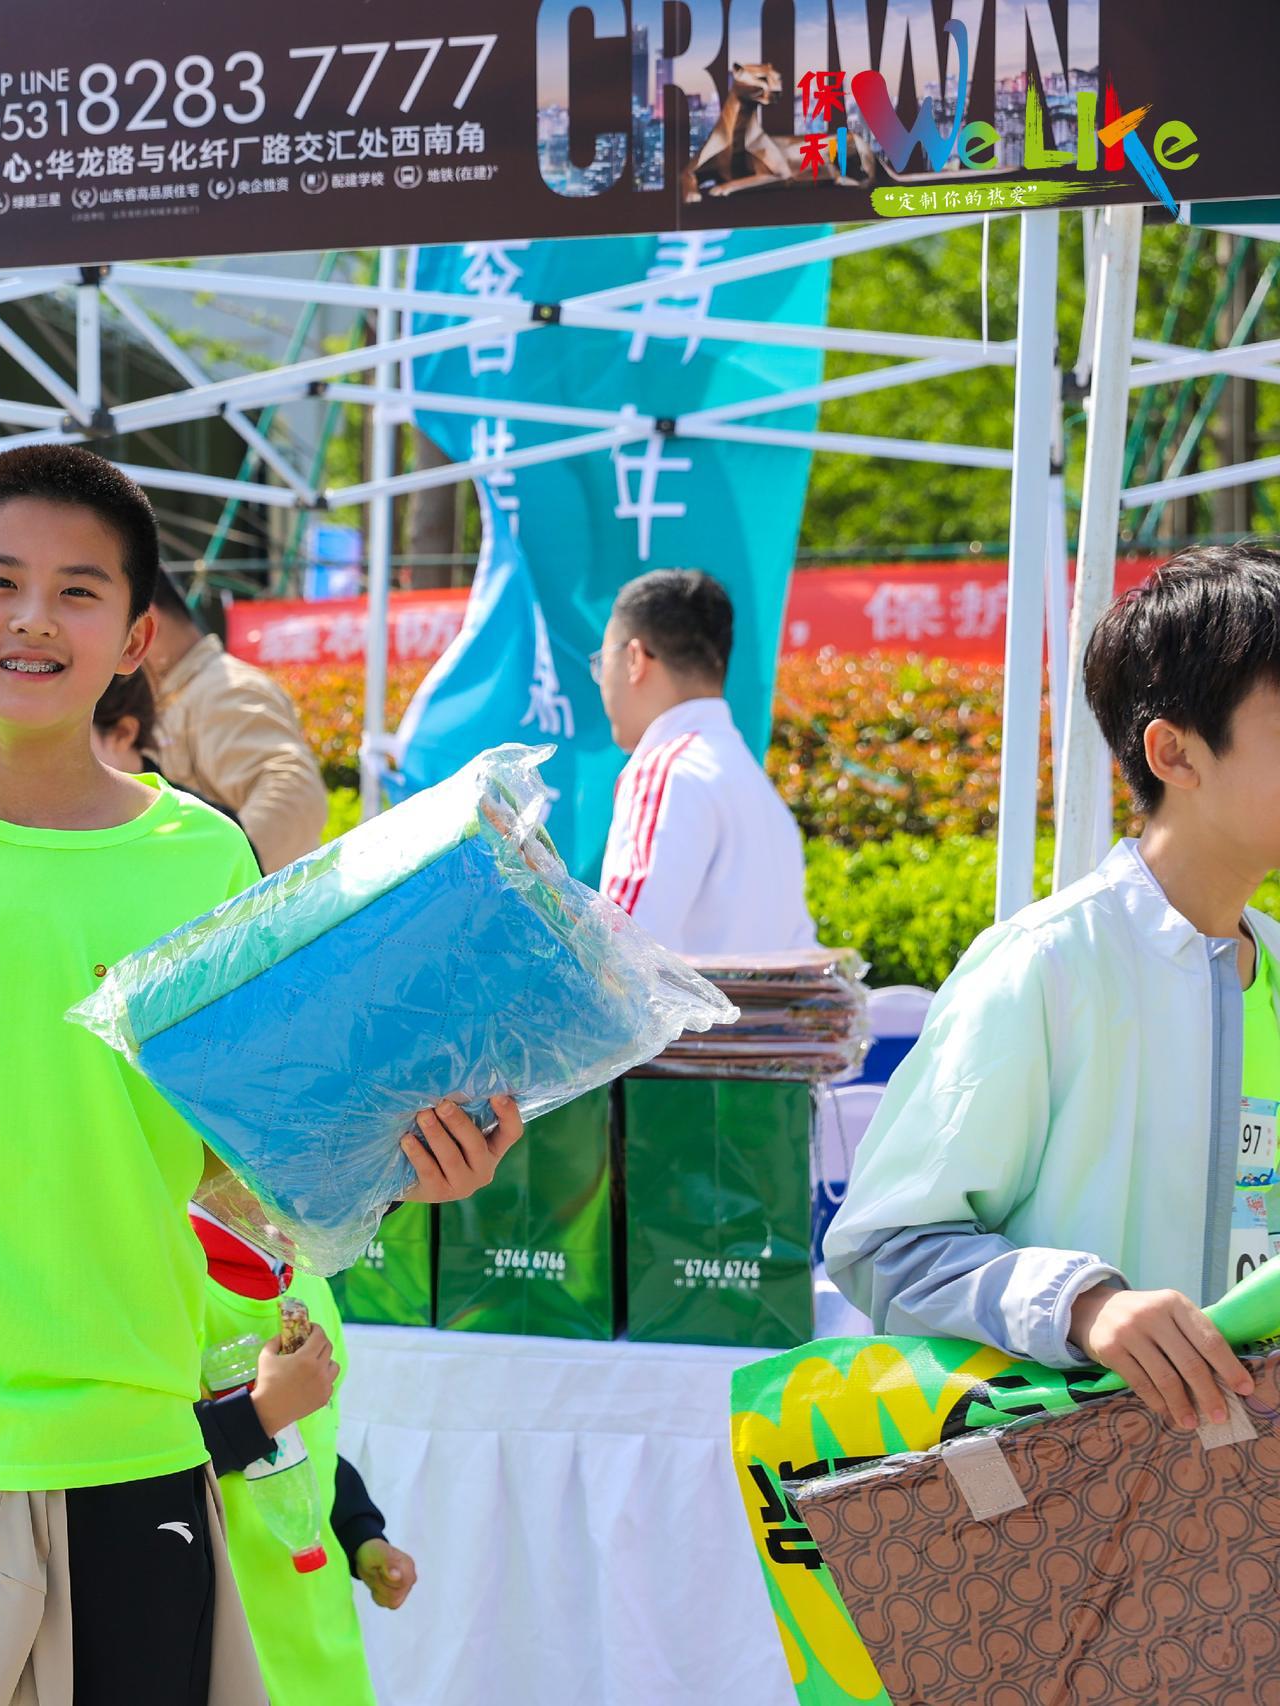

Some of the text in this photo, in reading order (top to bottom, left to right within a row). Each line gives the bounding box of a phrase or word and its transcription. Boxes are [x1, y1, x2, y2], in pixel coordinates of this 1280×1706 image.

[20, 68, 70, 95] LINE
[76, 50, 266, 137] 8283
[289, 34, 498, 121] 7777
[494, 1248, 566, 1270] 6766 6766
[685, 1258, 761, 1279] 6766 6766
